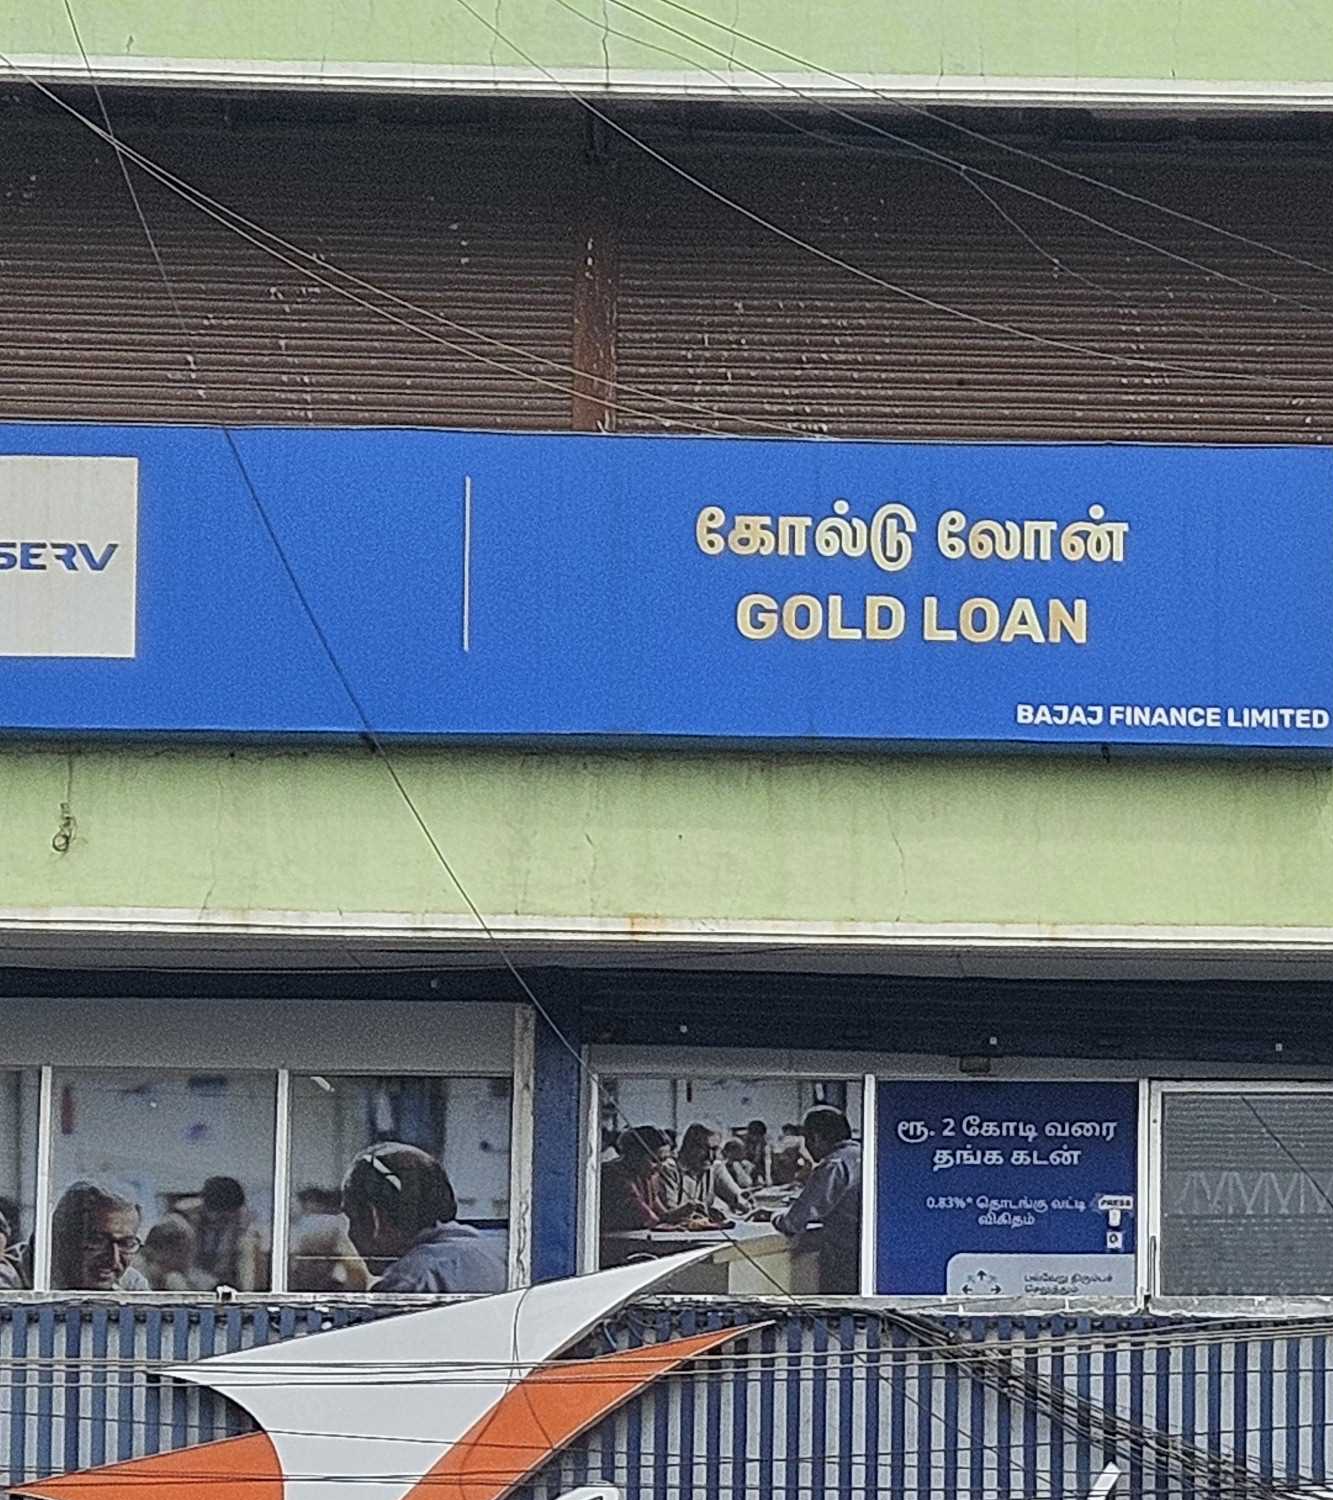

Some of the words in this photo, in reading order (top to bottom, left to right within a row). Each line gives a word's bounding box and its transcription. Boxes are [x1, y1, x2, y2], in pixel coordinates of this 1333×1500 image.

[696, 500, 917, 571] கோல்டு
[937, 504, 1129, 562] லோன்
[737, 595, 905, 640] GOLD
[924, 596, 1088, 643] LOAN
[1017, 704, 1103, 725] BAJAJ
[1110, 705, 1221, 728] FINANCE
[1228, 708, 1330, 729] LIMITED
[942, 1118, 955, 1137] 2
[962, 1115, 1038, 1141] கோடி
[1045, 1119, 1117, 1142] வரை
[933, 1147, 1004, 1171] தங்க
[1010, 1146, 1081, 1167] கடன்
